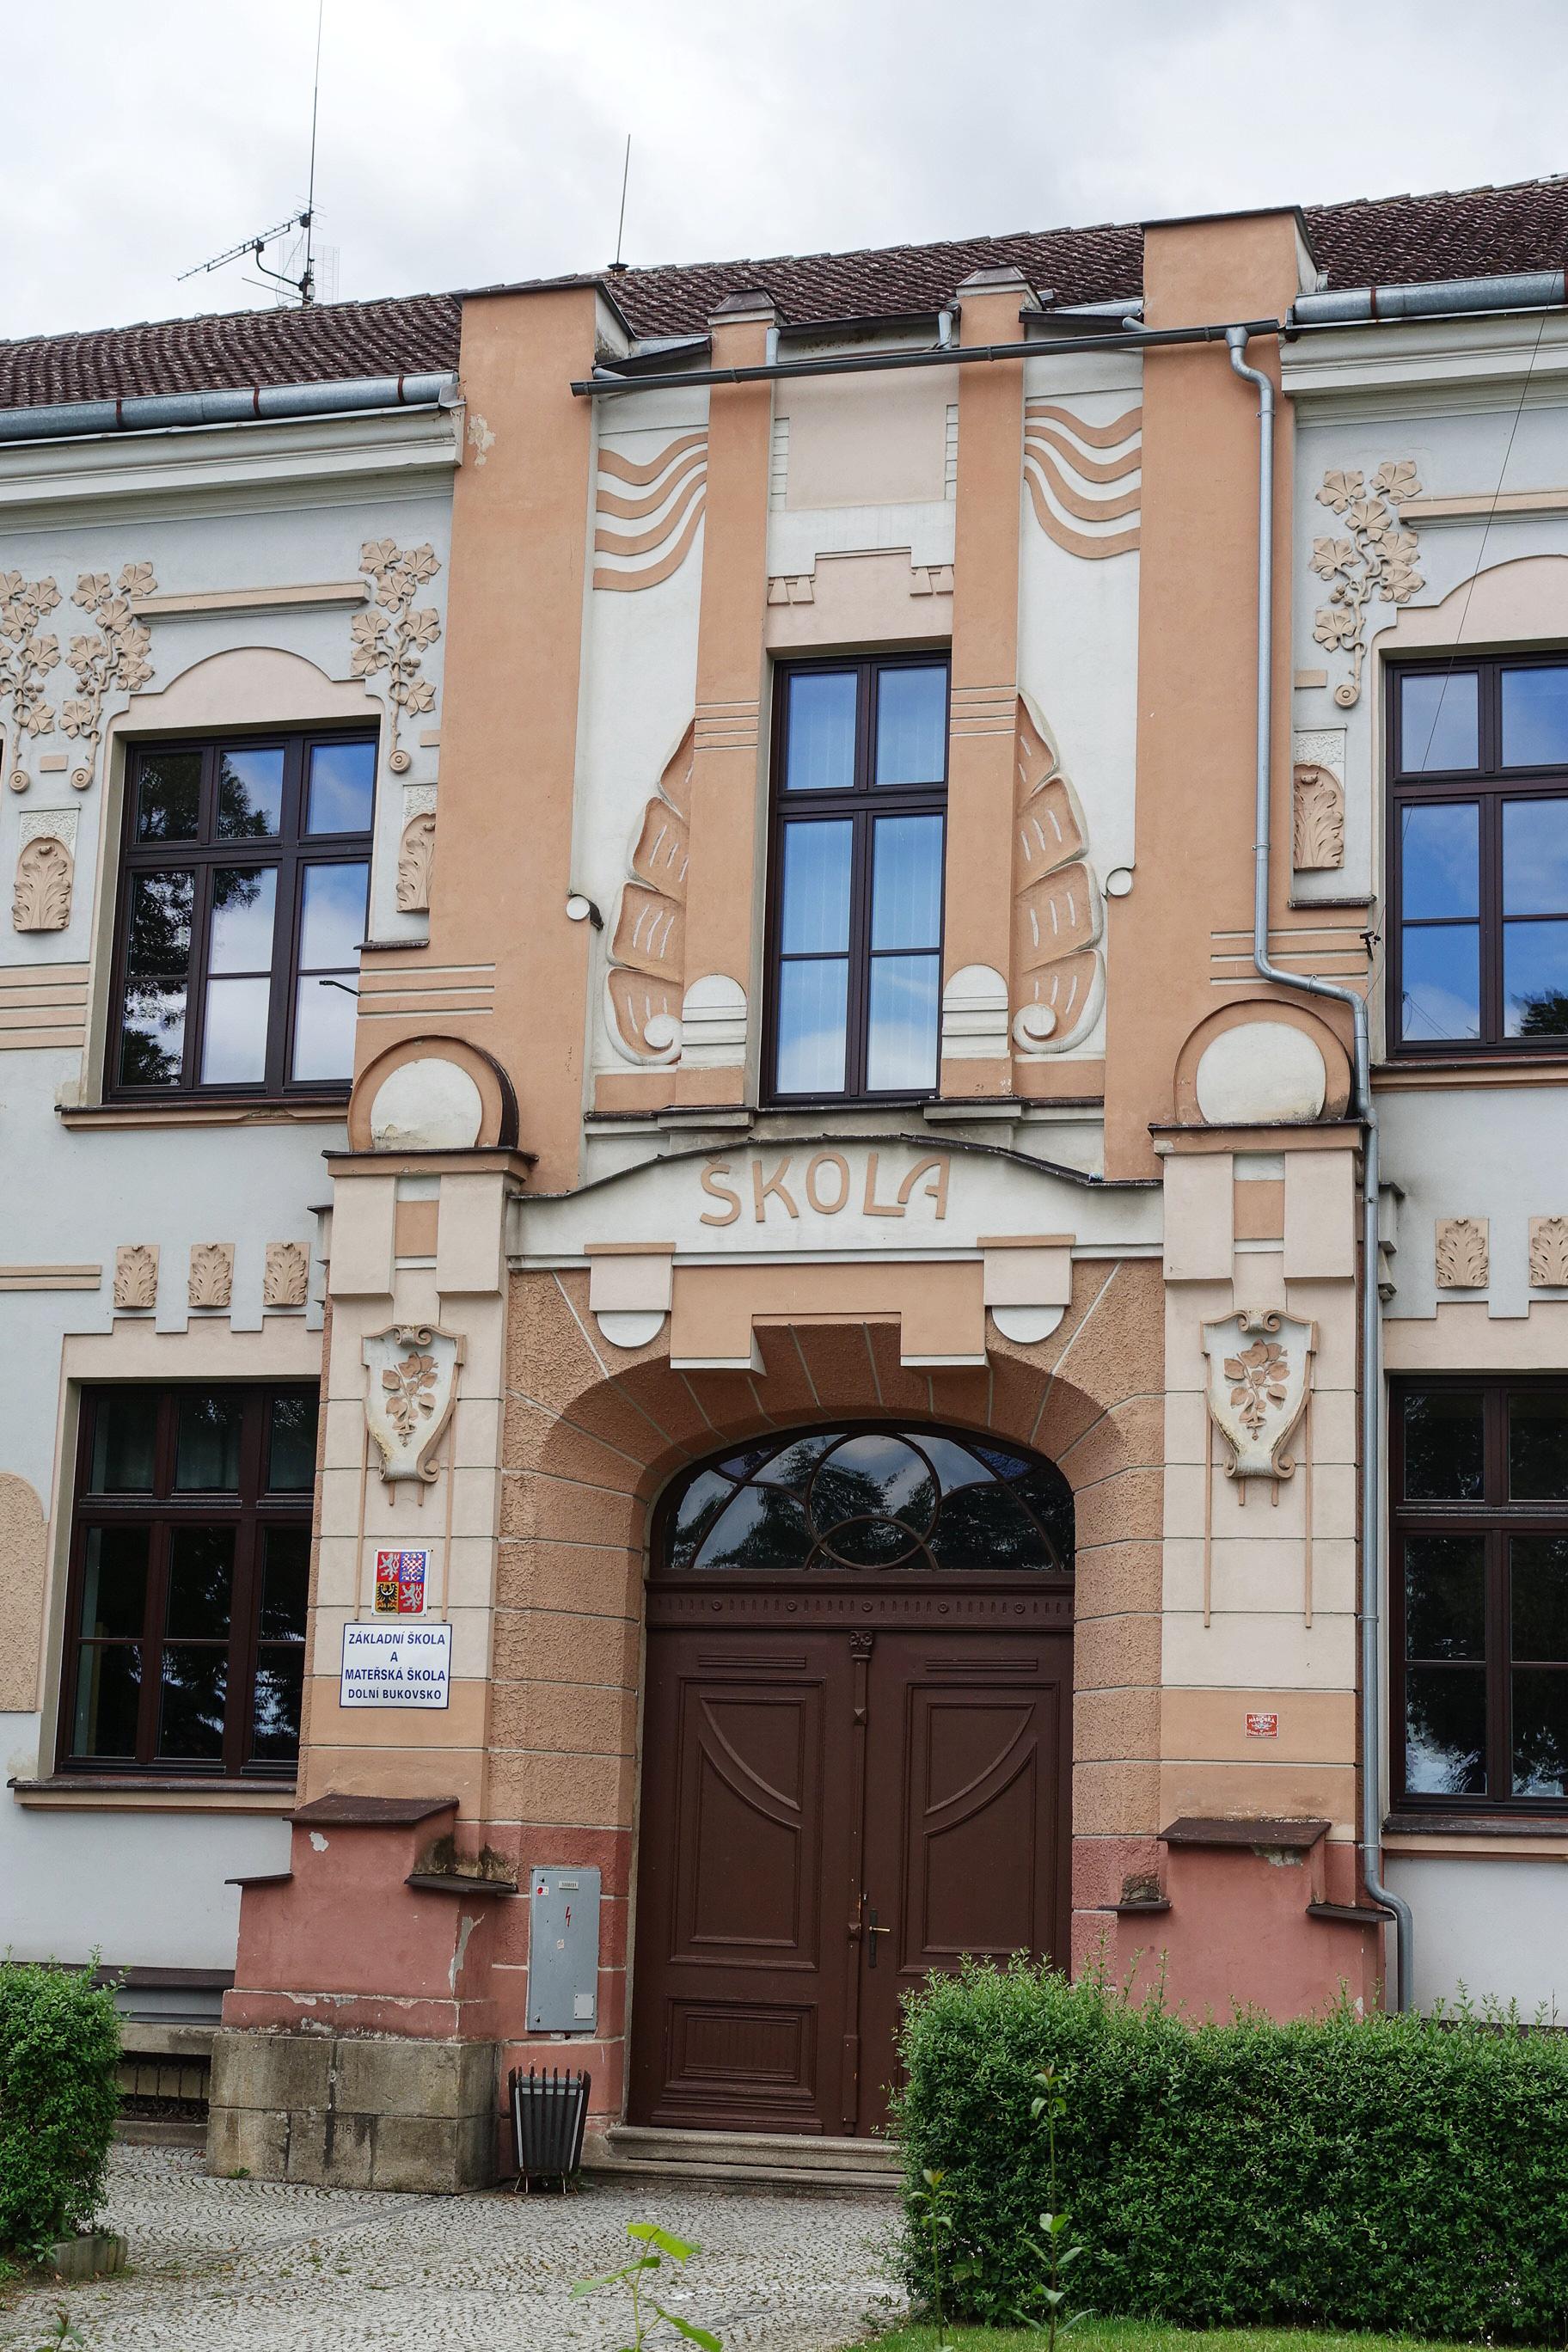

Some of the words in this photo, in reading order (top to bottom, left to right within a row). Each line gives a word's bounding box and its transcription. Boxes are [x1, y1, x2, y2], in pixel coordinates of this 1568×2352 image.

[348, 1631, 405, 1645] ZÁKLADNÍ
[407, 1631, 445, 1645] ŠKOLA
[390, 1651, 398, 1662] A
[345, 1667, 403, 1681] MATEŘSKÁ
[407, 1667, 445, 1681] ŠKOLA
[348, 1687, 379, 1699] DOLNÍ
[383, 1689, 441, 1700] BUKOVSKO
